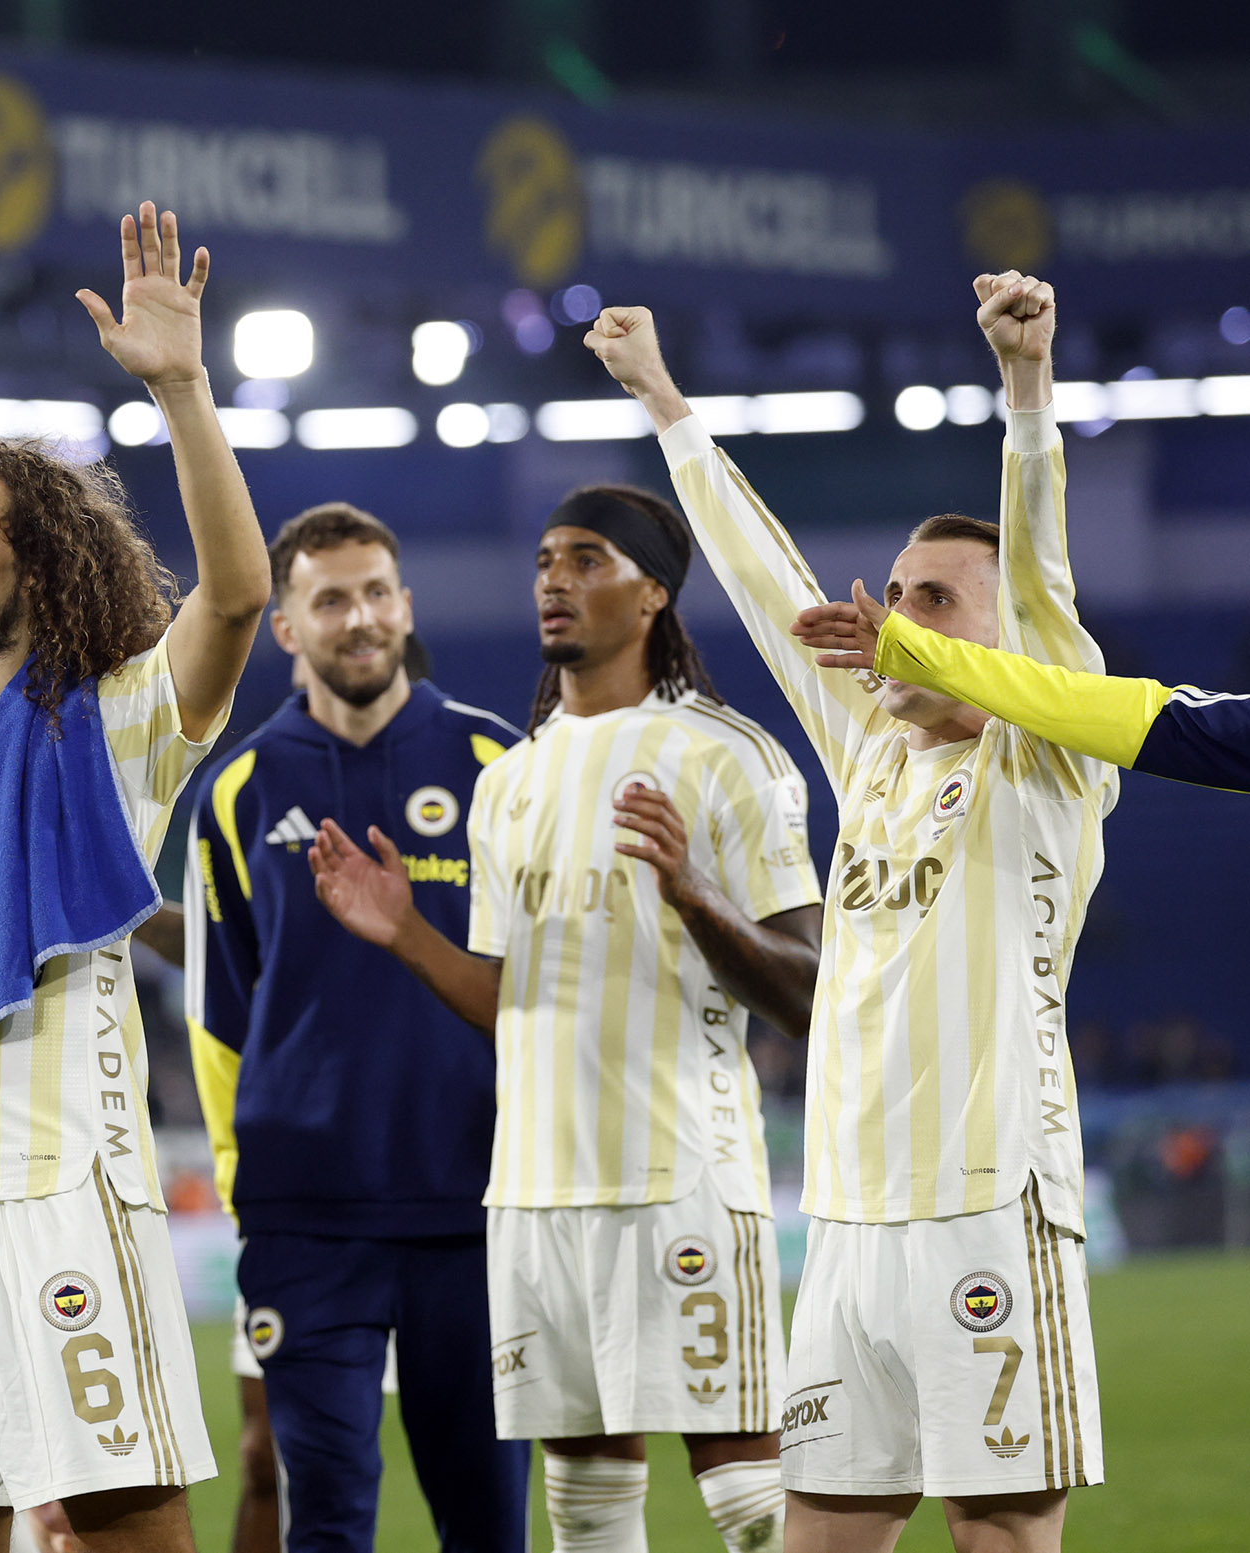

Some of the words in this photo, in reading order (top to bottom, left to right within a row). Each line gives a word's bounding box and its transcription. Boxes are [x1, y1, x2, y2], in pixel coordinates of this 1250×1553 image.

[57, 112, 406, 243] TURKCELL
[401, 853, 469, 887] tokoç
[681, 1292, 727, 1370] 3
[61, 1332, 125, 1424] 6
[973, 1336, 1024, 1426] 7
